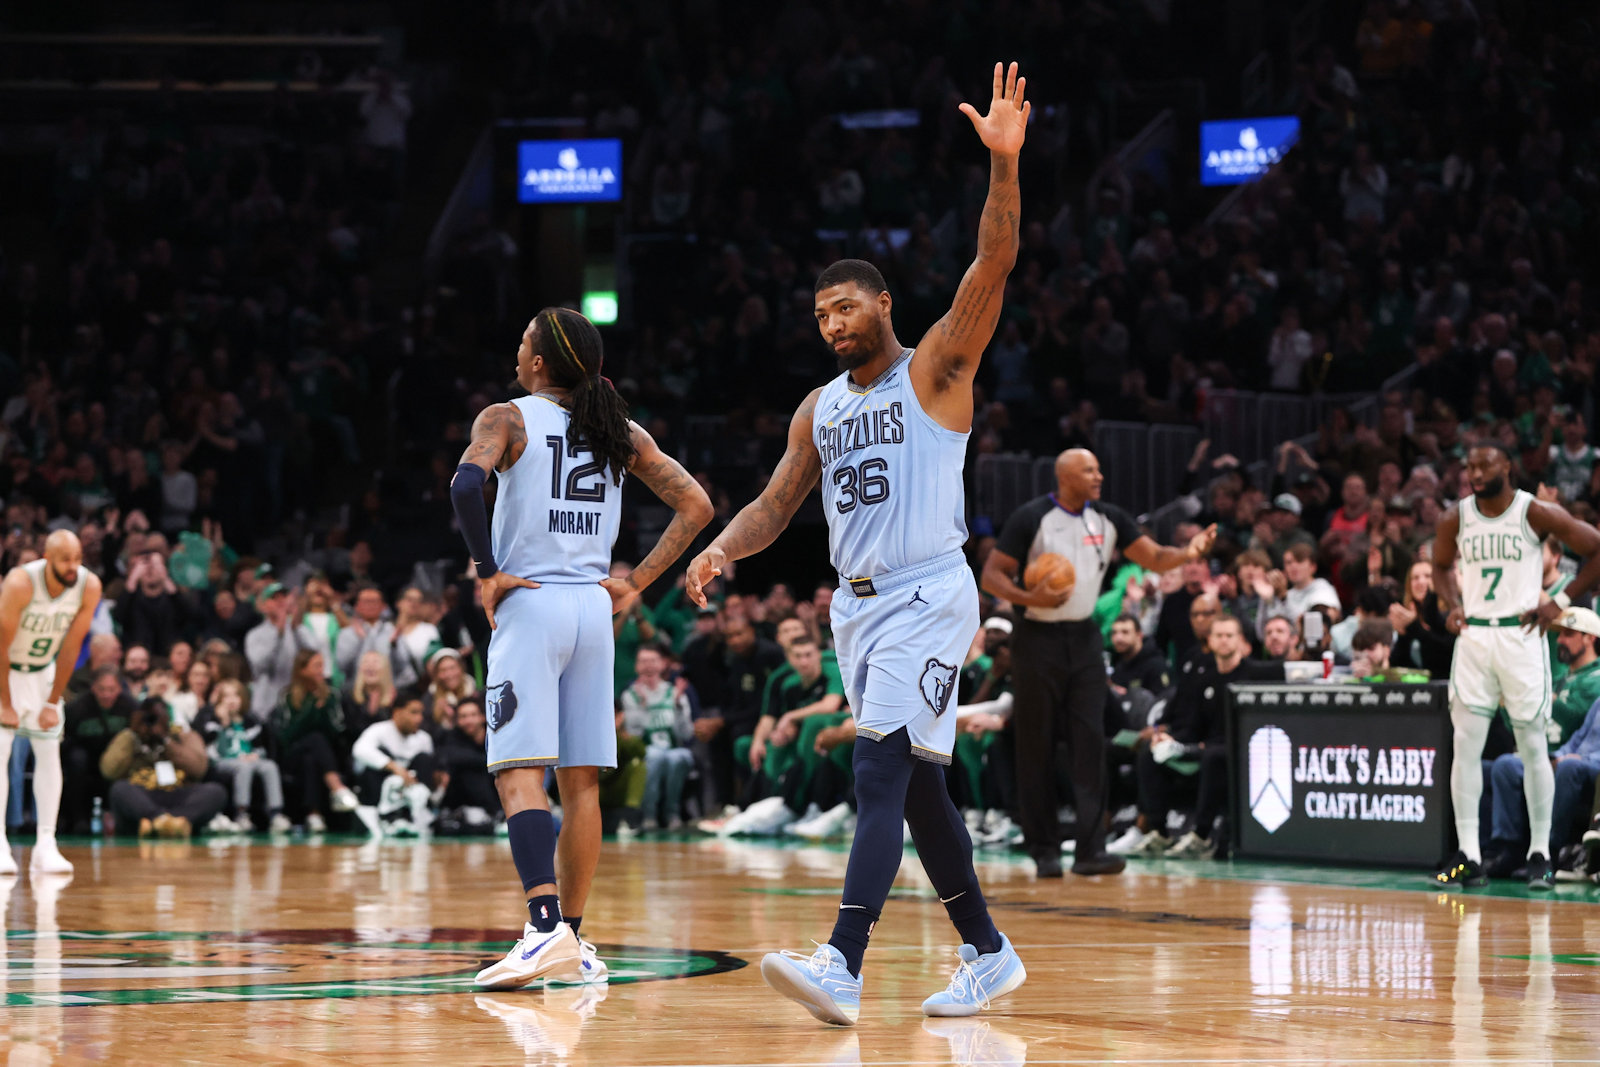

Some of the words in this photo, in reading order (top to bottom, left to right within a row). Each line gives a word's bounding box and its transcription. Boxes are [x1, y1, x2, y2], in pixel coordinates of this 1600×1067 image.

[818, 401, 905, 469] GRIZZLIES
[545, 435, 606, 503] 12
[833, 457, 890, 515] 36
[548, 509, 602, 536] MORANT
[1462, 532, 1522, 564] CELTICS
[1481, 567, 1503, 601] 7
[28, 638, 53, 657] 9
[1294, 744, 1371, 785] JACK'S
[1373, 746, 1437, 787] ABBY
[1305, 791, 1358, 819] CRAFT
[1359, 793, 1426, 823] LAGERS
